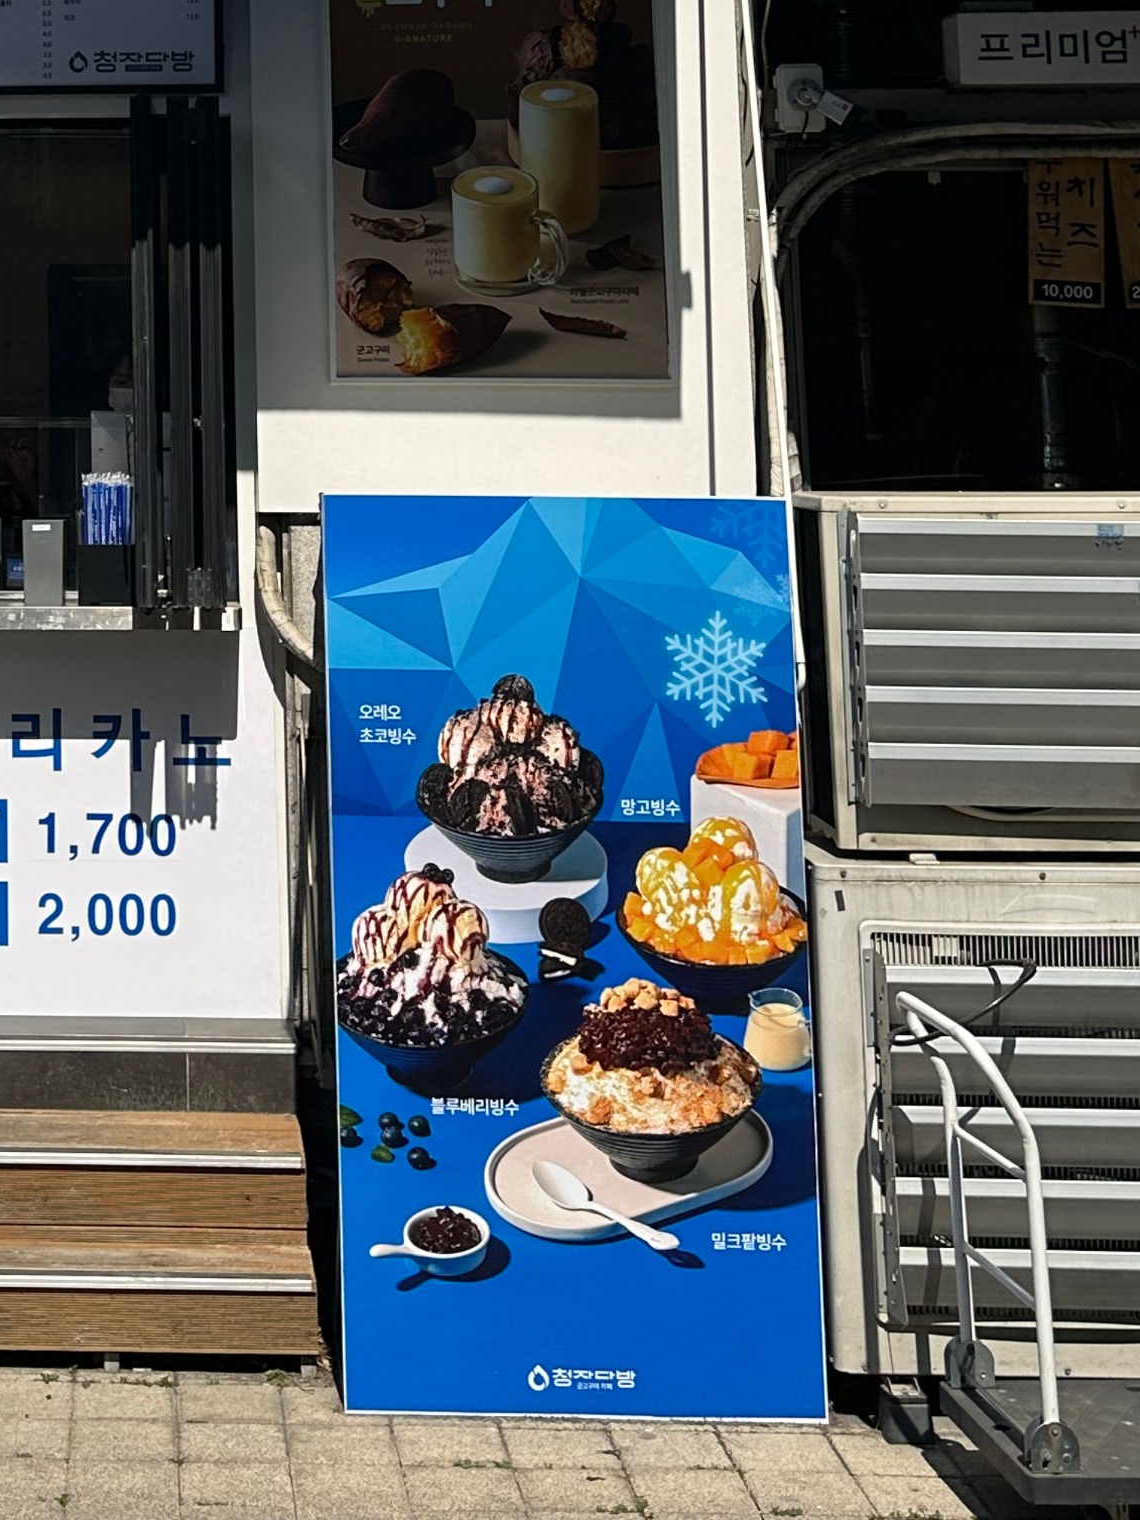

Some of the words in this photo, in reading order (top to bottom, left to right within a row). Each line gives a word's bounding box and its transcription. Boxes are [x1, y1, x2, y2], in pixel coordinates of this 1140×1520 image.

[394, 33, 453, 43] SIGNATURE
[1066, 176, 1100, 249] 치즈
[1041, 284, 1094, 300] 10,000
[356, 344, 390, 356] 군고구마
[358, 703, 402, 721] 오레오
[358, 727, 417, 746] 초코빙수
[620, 798, 681, 817] 망고빙수
[36, 813, 177, 861] 1,700
[36, 892, 177, 943] 2,000
[429, 1097, 520, 1117] 블루베리빙수
[711, 1232, 788, 1252] 밀크팥빙수
[551, 1367, 637, 1389] 청자다방
